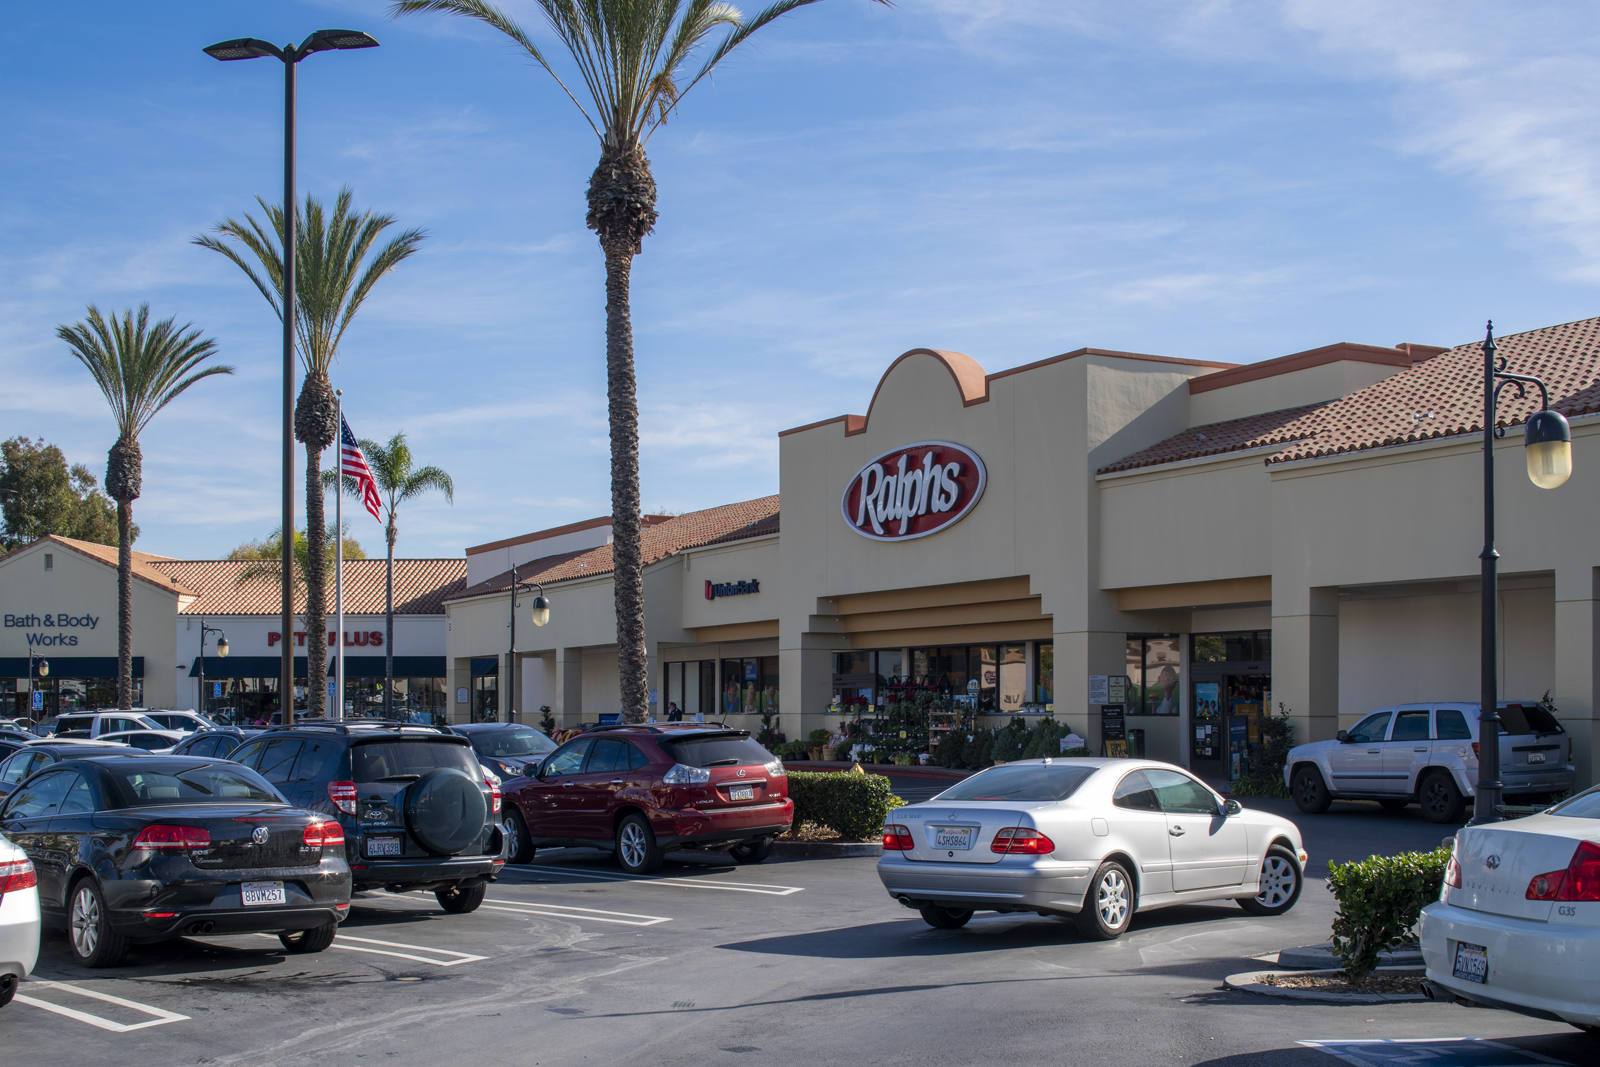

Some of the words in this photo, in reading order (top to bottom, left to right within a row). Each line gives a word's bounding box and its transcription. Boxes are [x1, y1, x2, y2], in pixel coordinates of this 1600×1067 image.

[855, 450, 962, 535] Ralphs
[4, 614, 41, 628] Bath
[43, 614, 55, 627] &
[57, 613, 99, 630] Body
[26, 633, 78, 647] Works
[937, 835, 967, 846] 4SHS864
[244, 888, 283, 903] 8BVM257
[1558, 905, 1576, 918] G35
